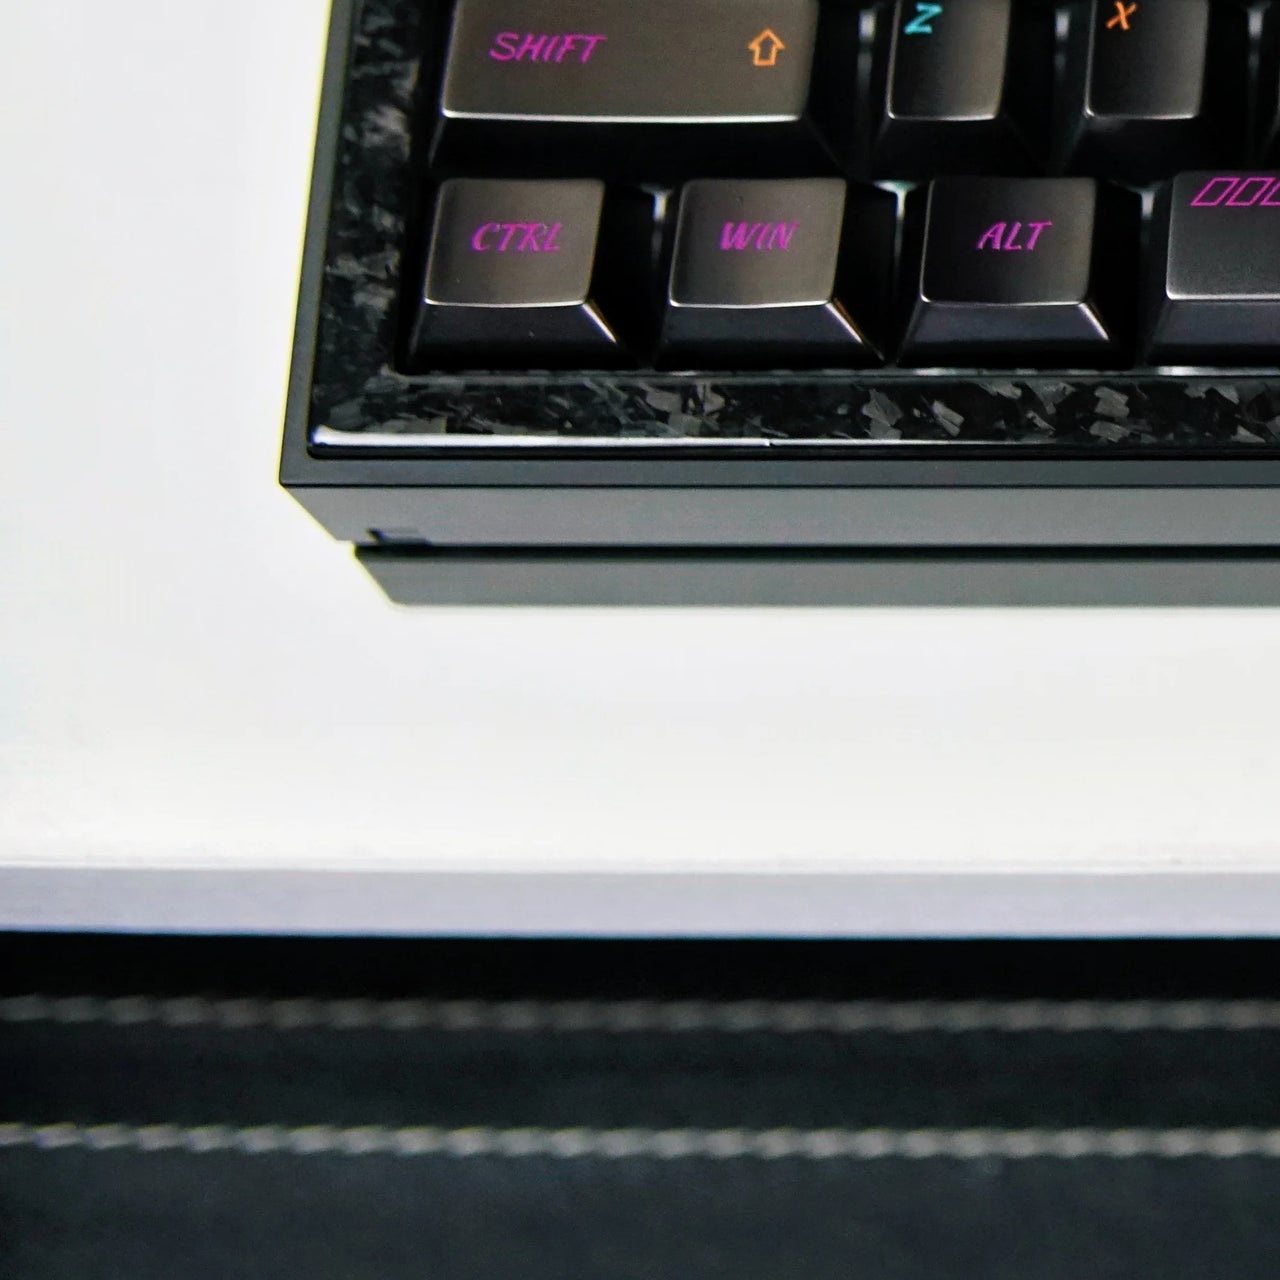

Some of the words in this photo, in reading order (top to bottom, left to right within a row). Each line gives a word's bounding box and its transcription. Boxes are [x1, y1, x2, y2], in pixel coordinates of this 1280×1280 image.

[903, 2, 942, 35] Z
[1106, 0, 1137, 31] X
[489, 31, 605, 63] SHIFT
[470, 221, 561, 252] CTRL
[719, 221, 798, 251] WIN
[976, 220, 1052, 252] ALT
